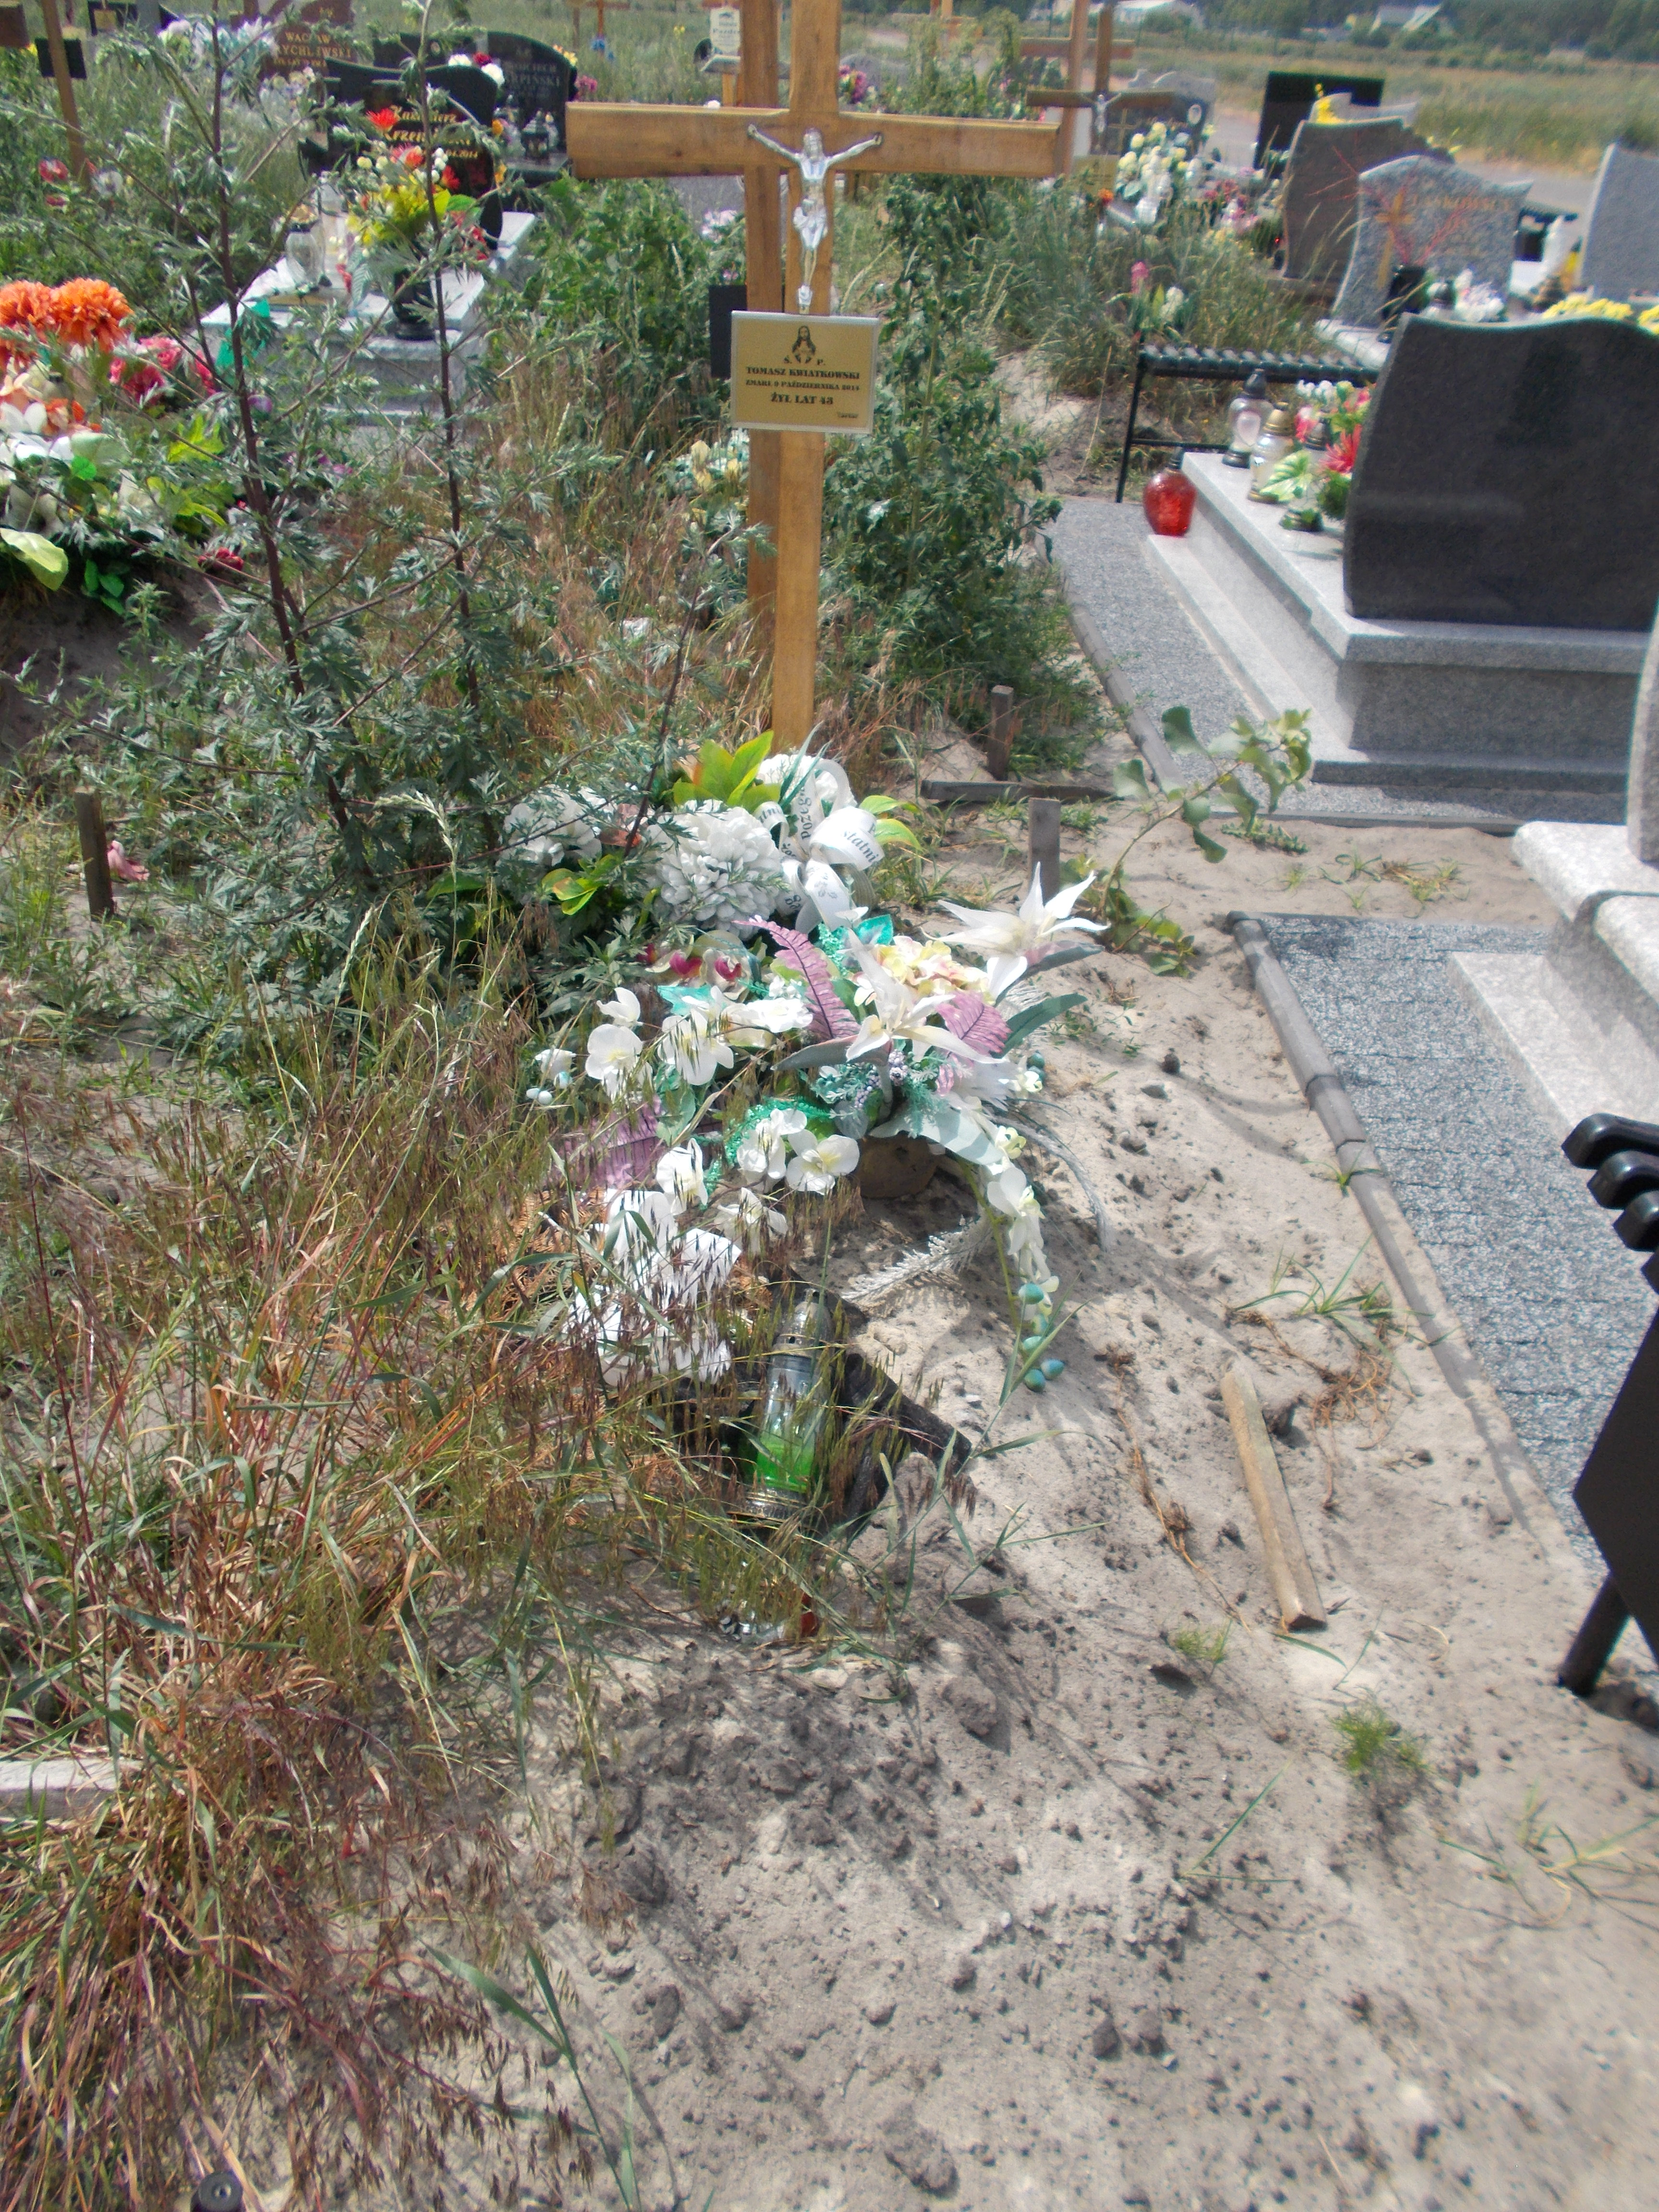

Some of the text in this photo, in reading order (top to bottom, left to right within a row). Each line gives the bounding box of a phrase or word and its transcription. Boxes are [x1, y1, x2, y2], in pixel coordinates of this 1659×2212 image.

[746, 366, 860, 380] TOMASZ KWIATKOWSKI
[794, 394, 817, 404] LAT
